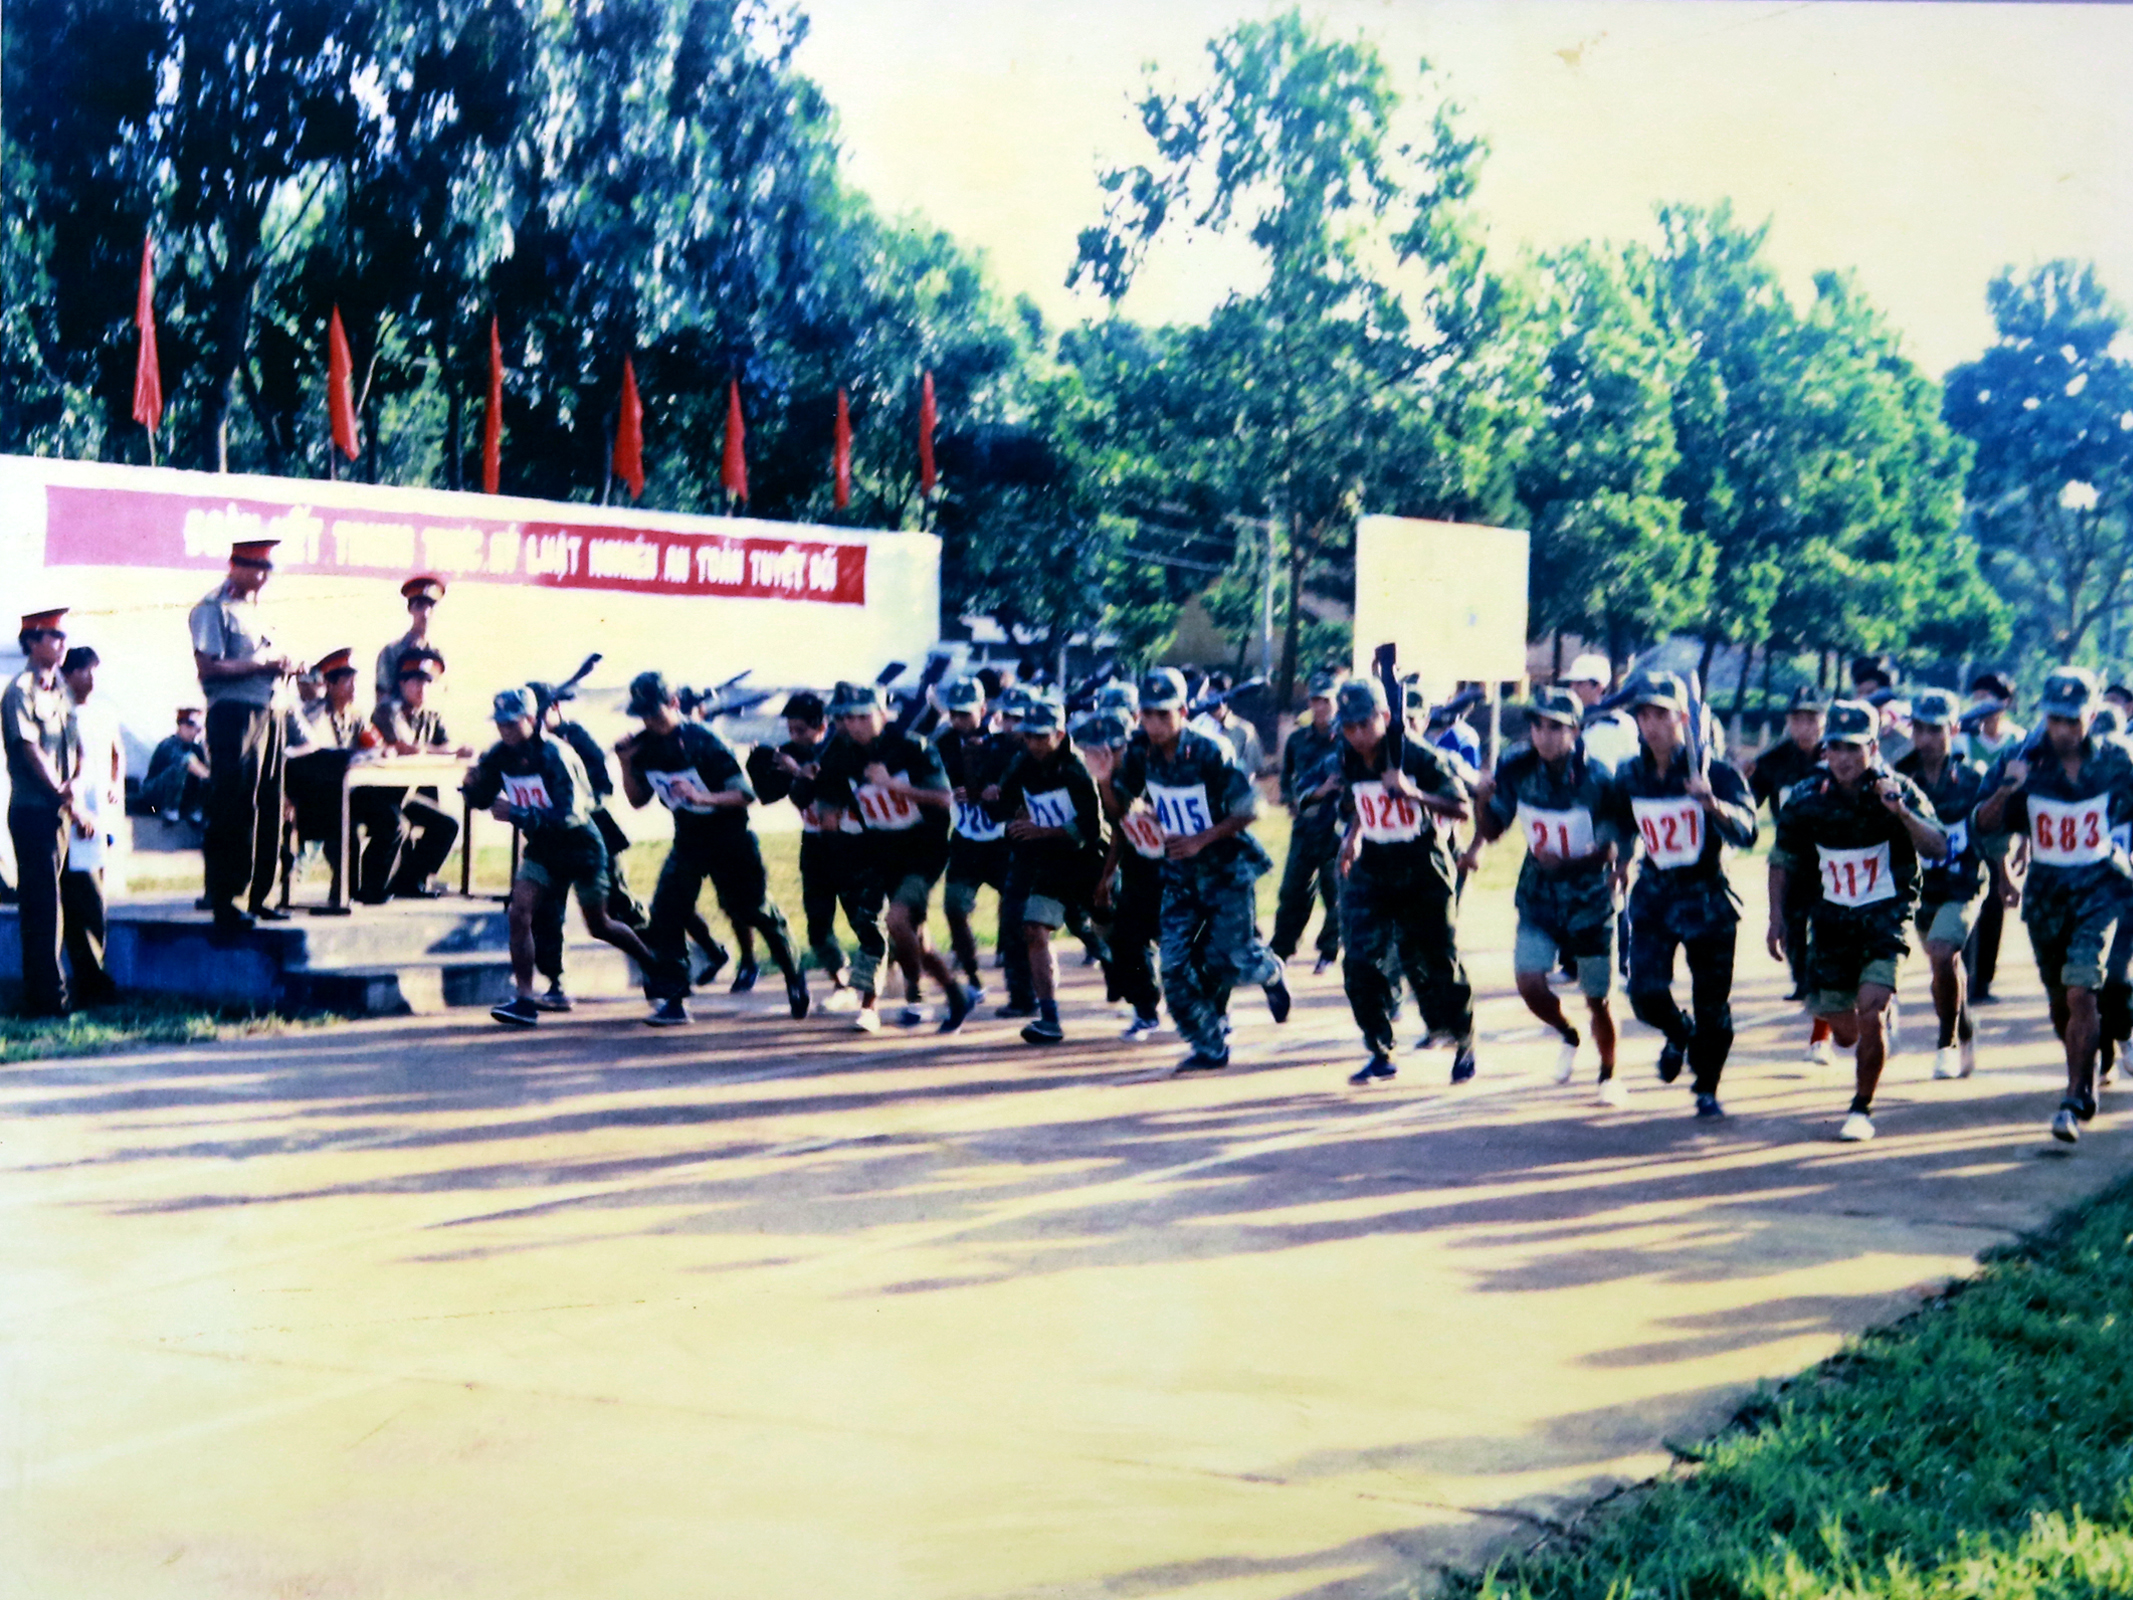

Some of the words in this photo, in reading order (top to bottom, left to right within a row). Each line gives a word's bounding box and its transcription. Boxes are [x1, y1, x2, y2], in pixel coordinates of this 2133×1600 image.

[1641, 808, 1698, 854] 027
[2035, 811, 2100, 852] 683
[1828, 857, 1879, 898] 117
